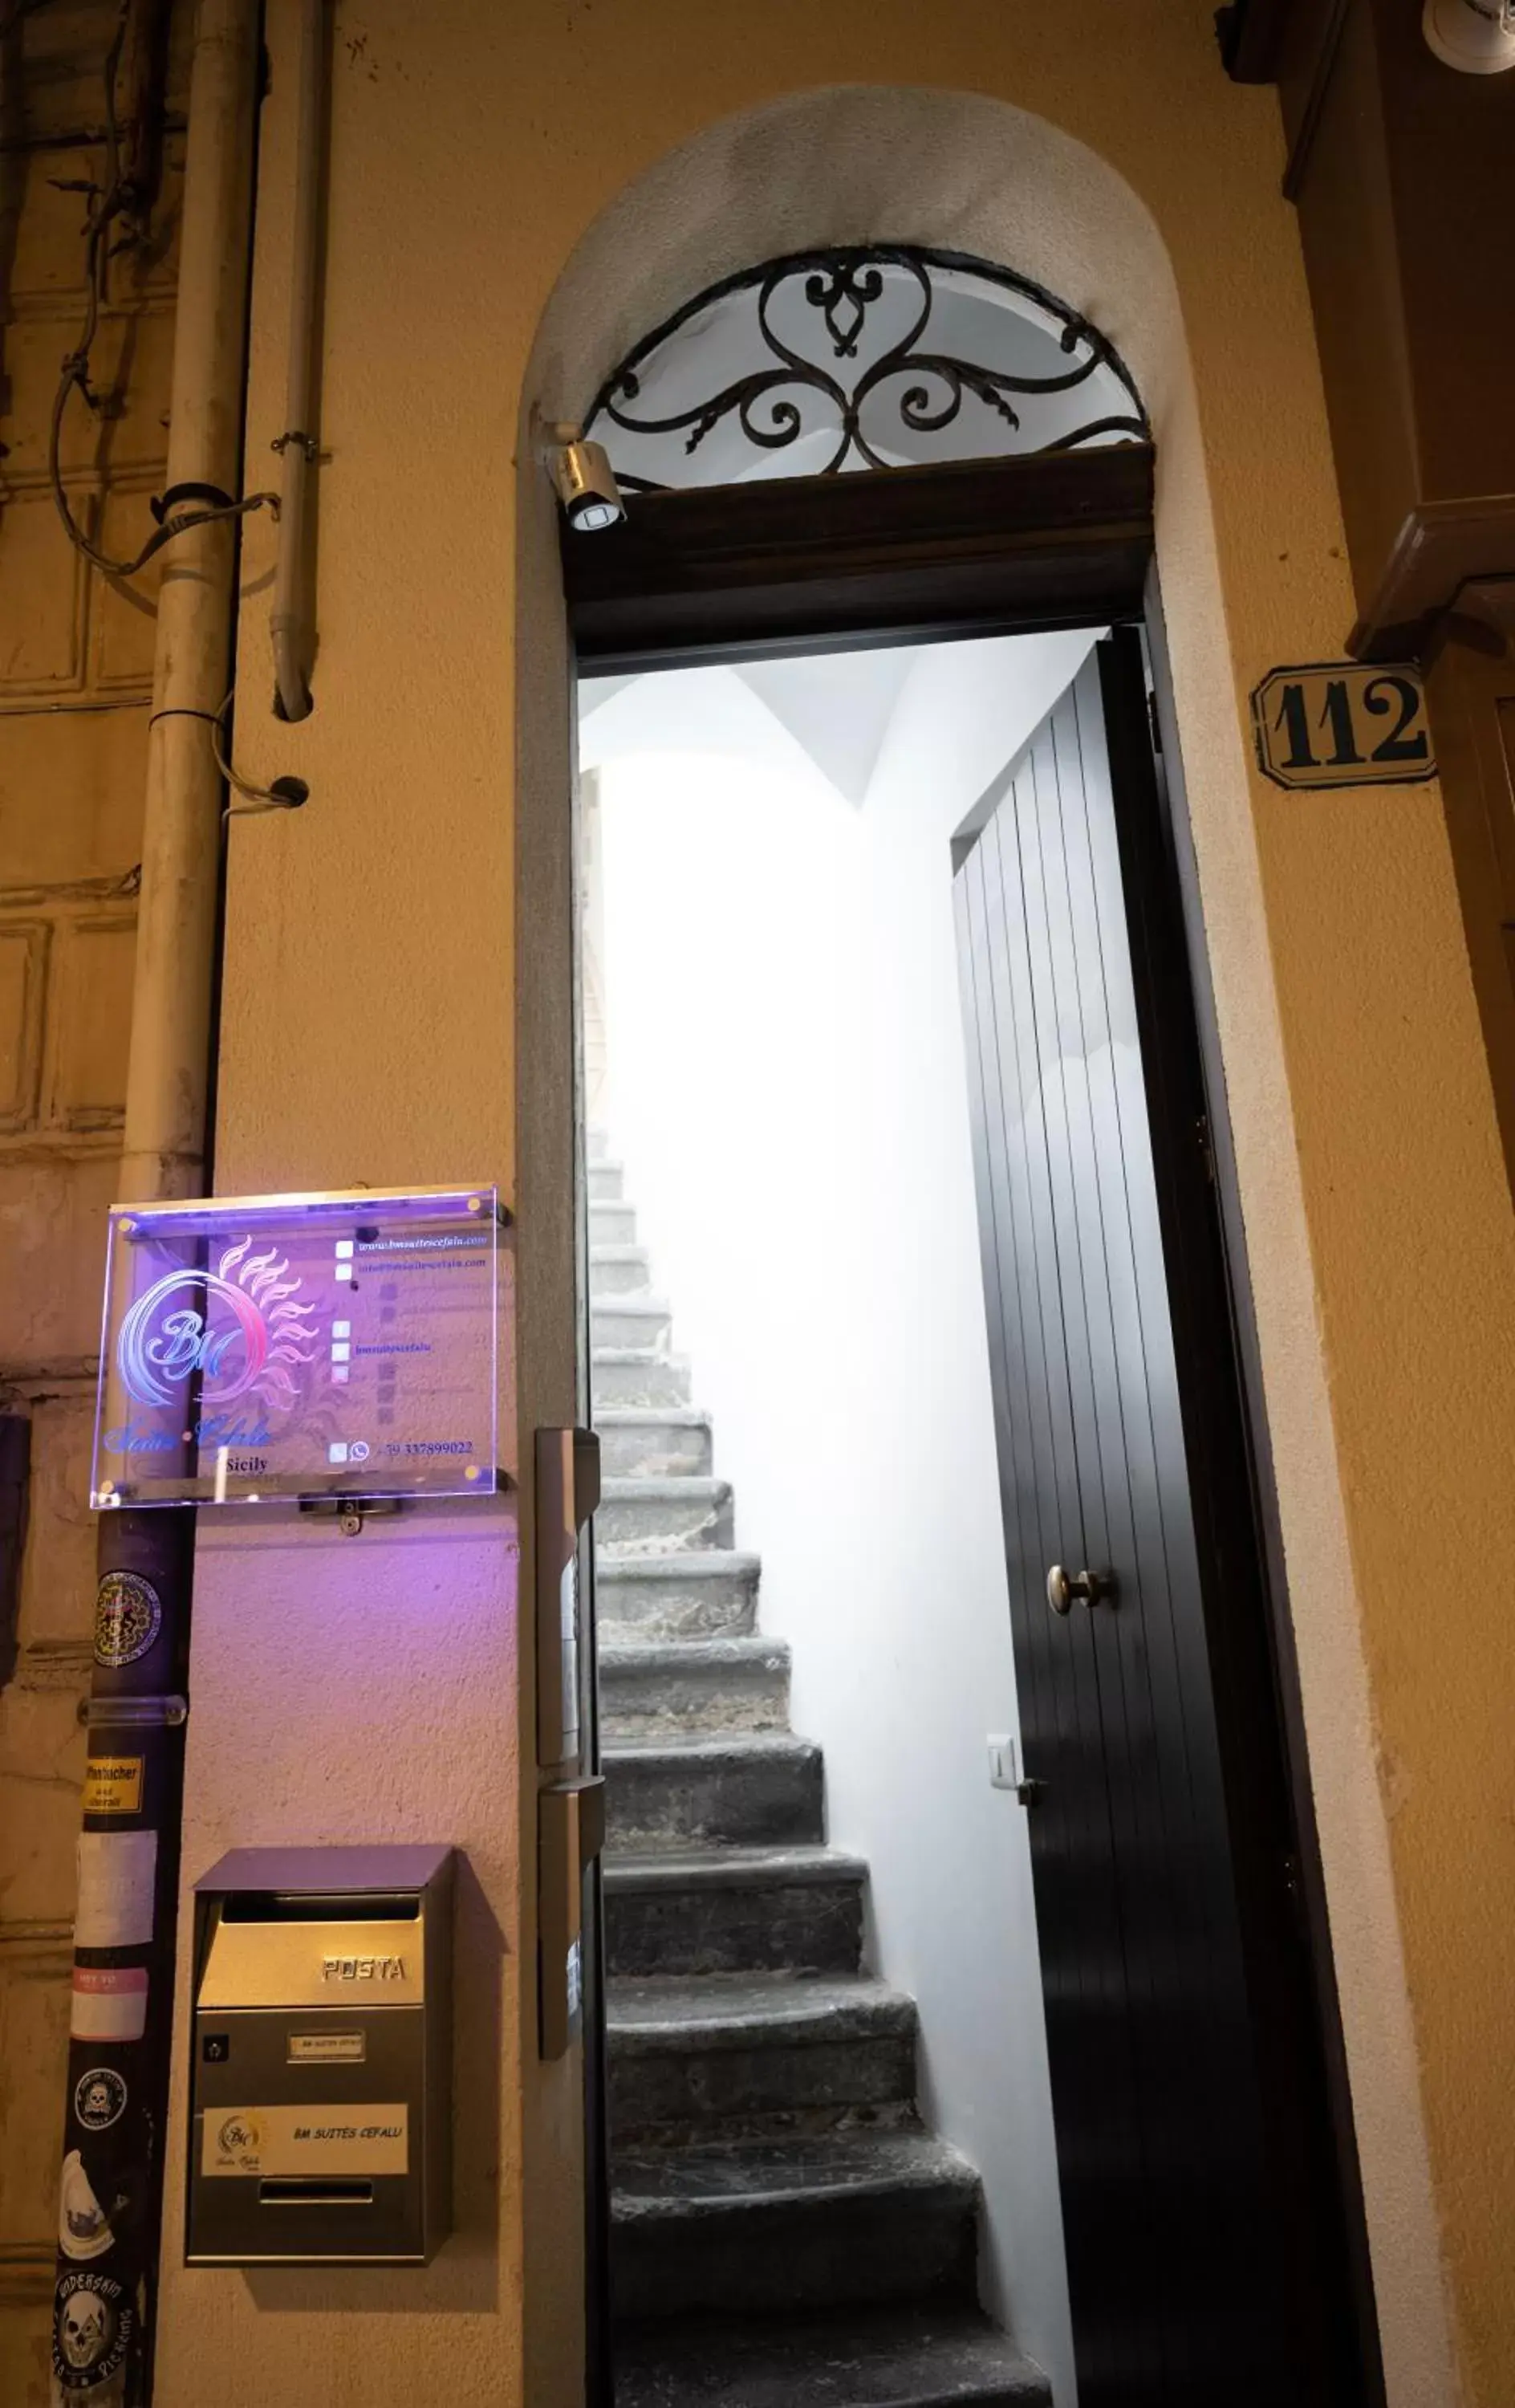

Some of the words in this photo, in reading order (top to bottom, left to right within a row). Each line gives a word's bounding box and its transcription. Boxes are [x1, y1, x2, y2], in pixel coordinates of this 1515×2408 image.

[1274, 676, 1428, 768] 112
[226, 1456, 268, 1474] Sicily
[322, 1955, 406, 1982] POSTA
[293, 2127, 311, 2140] BM
